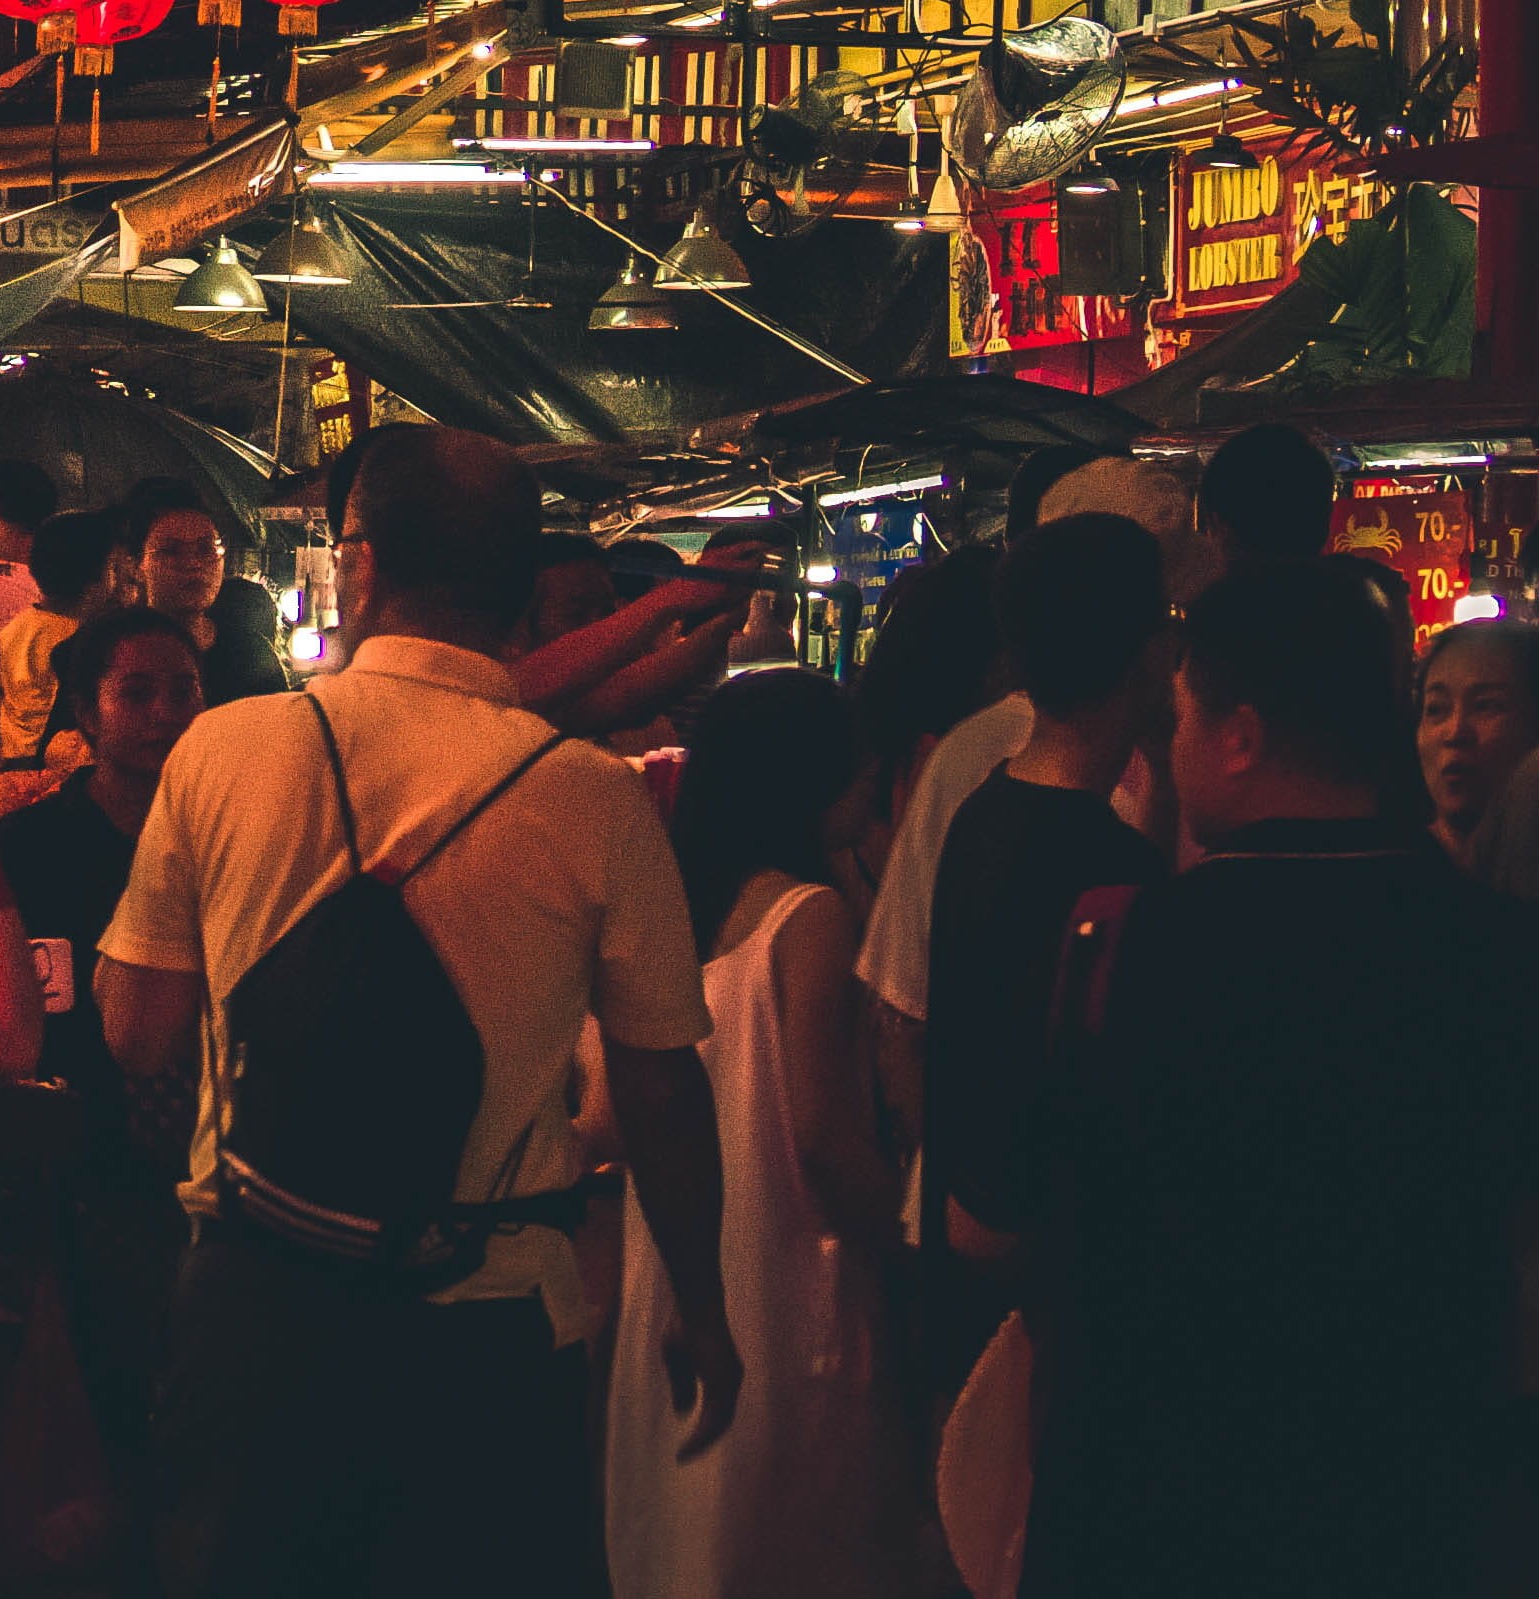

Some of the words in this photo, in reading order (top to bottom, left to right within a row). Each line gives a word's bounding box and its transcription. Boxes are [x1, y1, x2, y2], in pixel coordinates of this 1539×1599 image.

[1187, 154, 1280, 232] JUMBO
[1188, 233, 1283, 293] LOBSTER
[1417, 566, 1465, 601] 70.-
